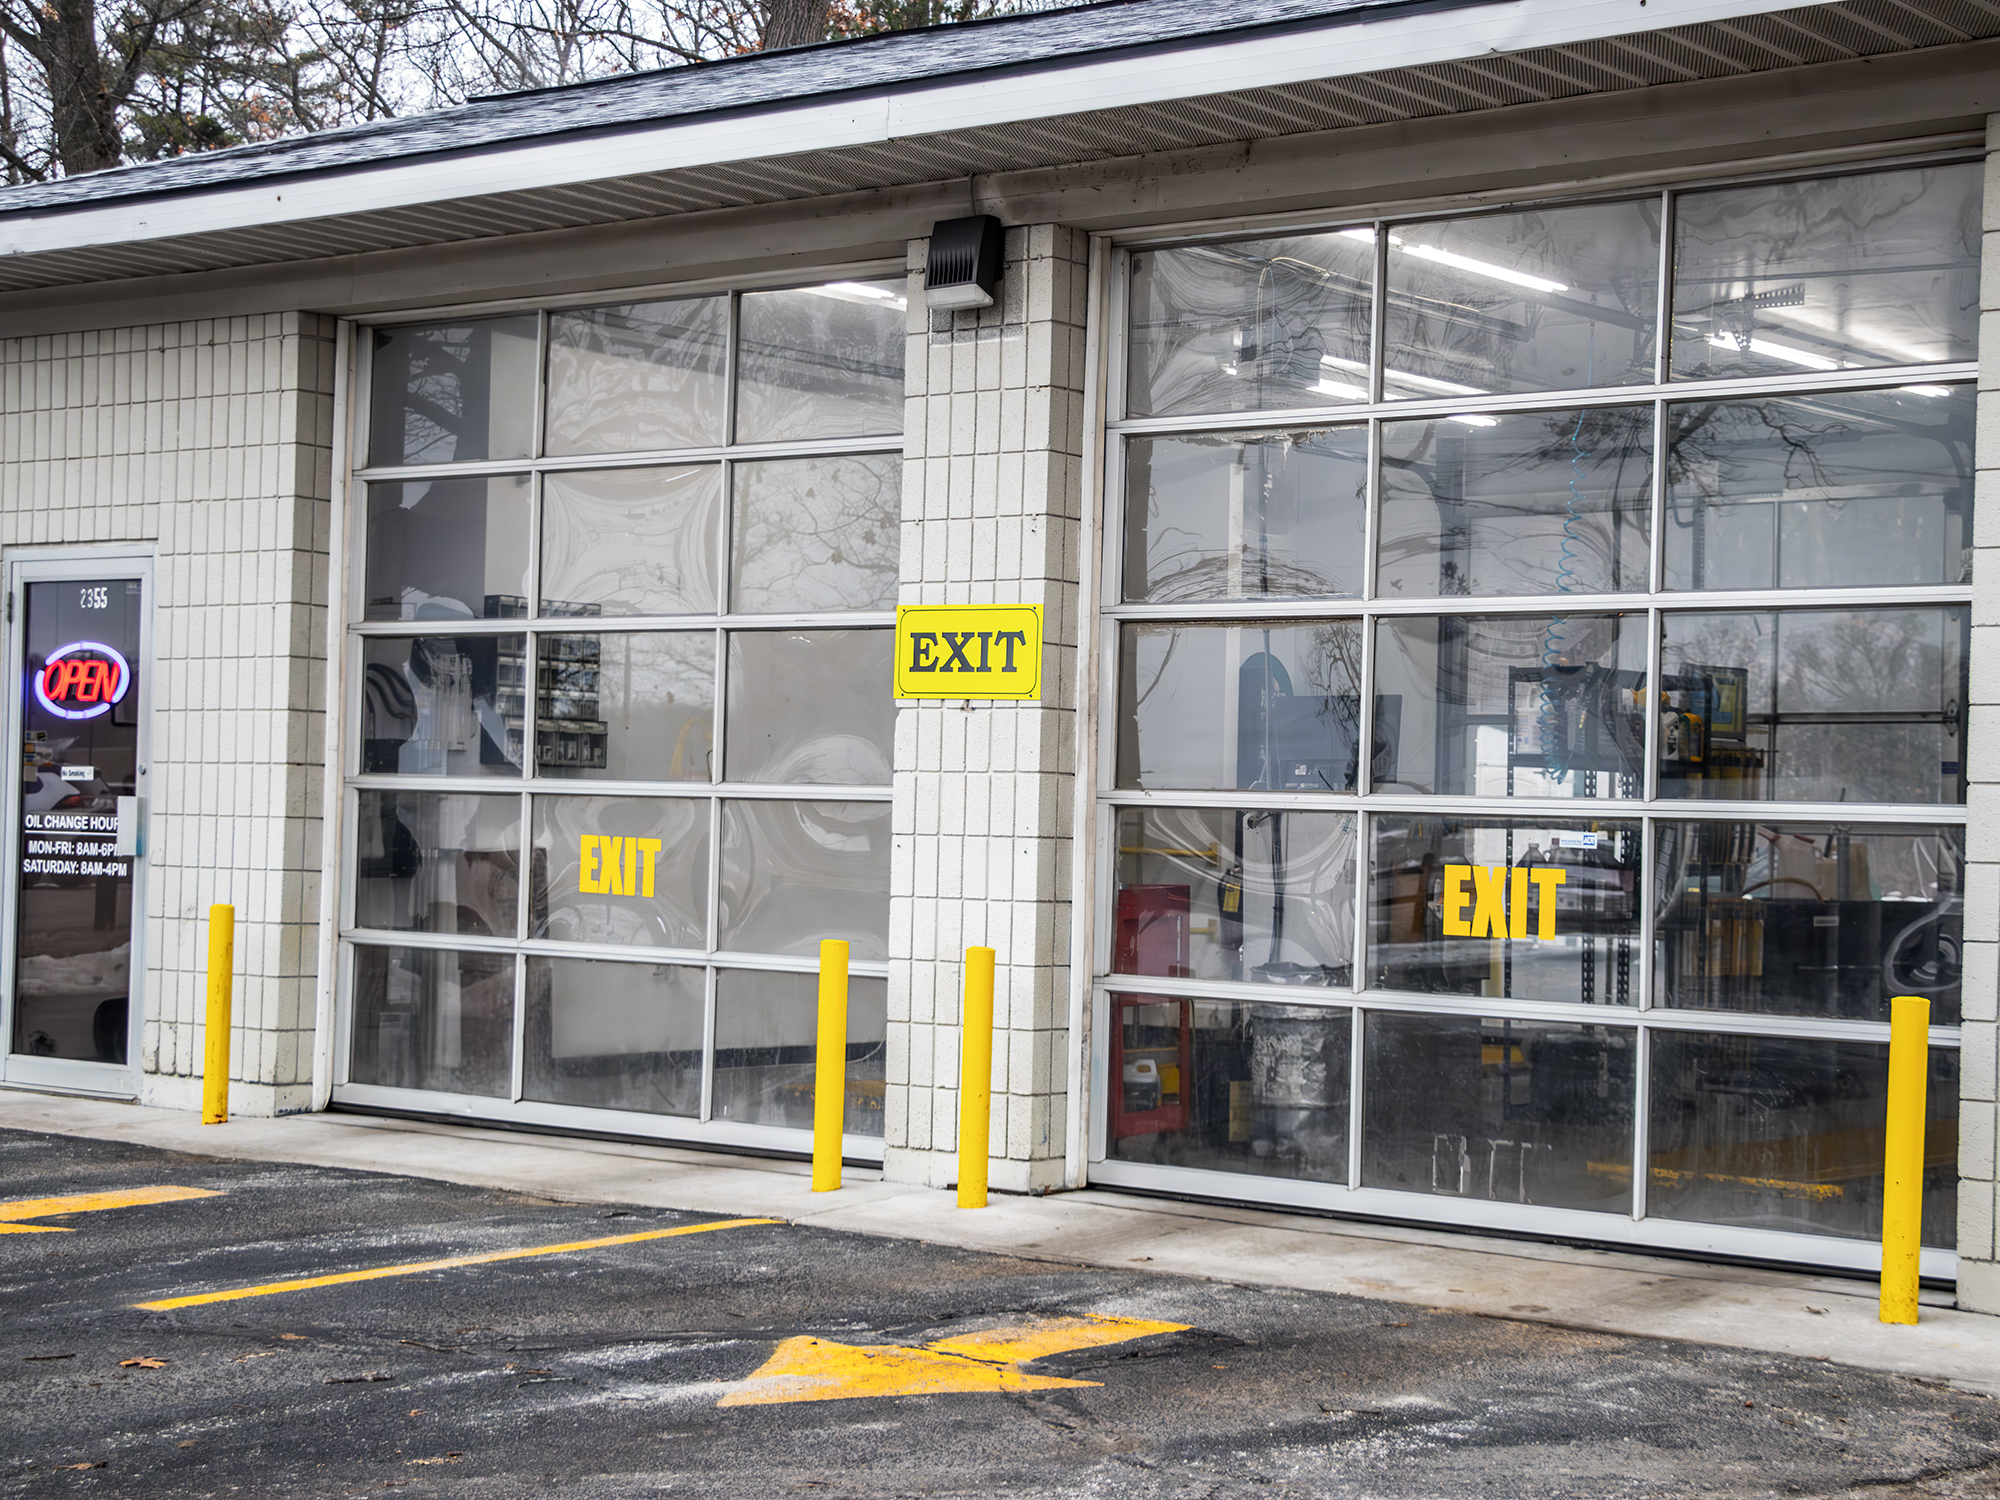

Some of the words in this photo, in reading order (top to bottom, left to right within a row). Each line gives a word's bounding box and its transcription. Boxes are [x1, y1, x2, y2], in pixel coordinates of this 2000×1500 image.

[80, 587, 108, 609] 2355
[909, 630, 1026, 673] EXIT
[43, 659, 121, 703] OPEN
[25, 814, 43, 829] OIL
[44, 815, 89, 830] CHANGE
[90, 816, 118, 831] HOUR
[28, 840, 75, 855] MON-FRI:
[23, 859, 79, 874] SATURDAY:
[80, 861, 128, 877] 8AM-4PM
[579, 833, 662, 898] EXIT
[1443, 864, 1567, 941] EXIT
